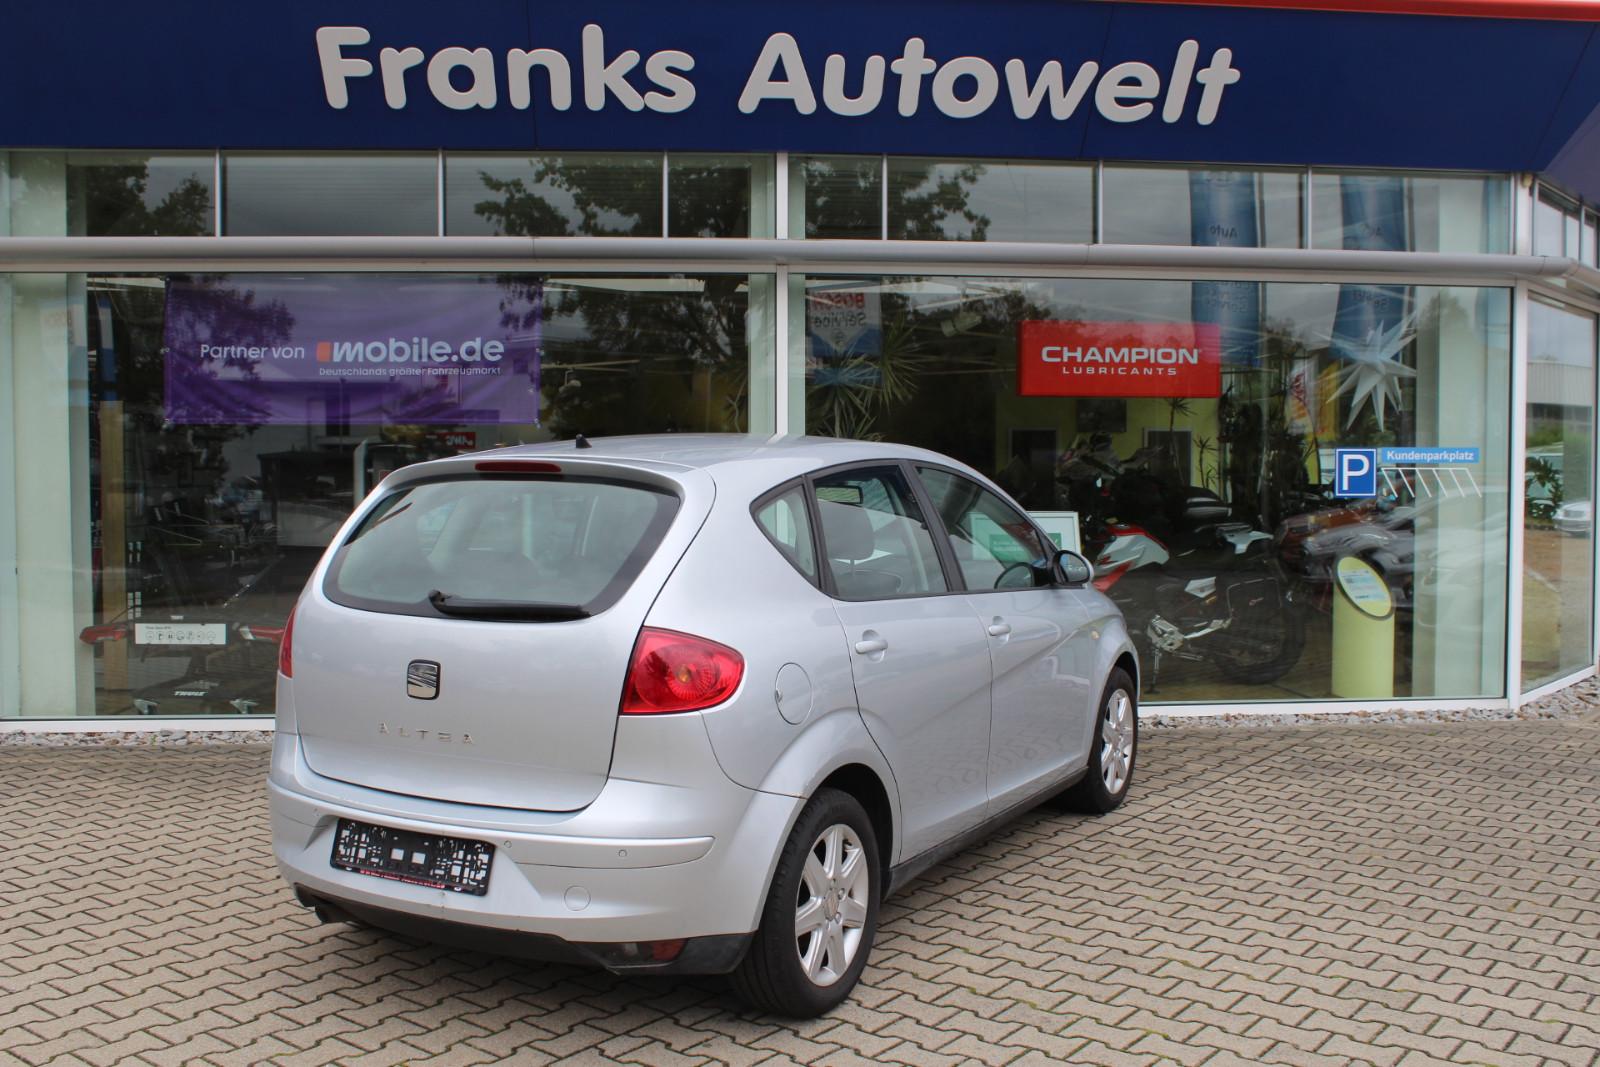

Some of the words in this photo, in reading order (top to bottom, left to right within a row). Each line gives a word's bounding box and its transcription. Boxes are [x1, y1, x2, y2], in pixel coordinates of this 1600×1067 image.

[315, 23, 697, 114] Franks
[737, 31, 1242, 126] Autowelt
[200, 344, 268, 359] Partner
[272, 346, 305, 359] von
[332, 337, 505, 363] mobile.de
[1041, 346, 1199, 365] CHAMPION
[319, 367, 387, 377] Deutschlands
[389, 367, 425, 377] größter
[427, 366, 501, 377] Fahrzeugmarkt
[1063, 366, 1177, 376] LUBRICANTS
[1341, 453, 1370, 491] P
[1386, 449, 1475, 463] Kundenparkplatz
[379, 721, 473, 744] ALTEA
